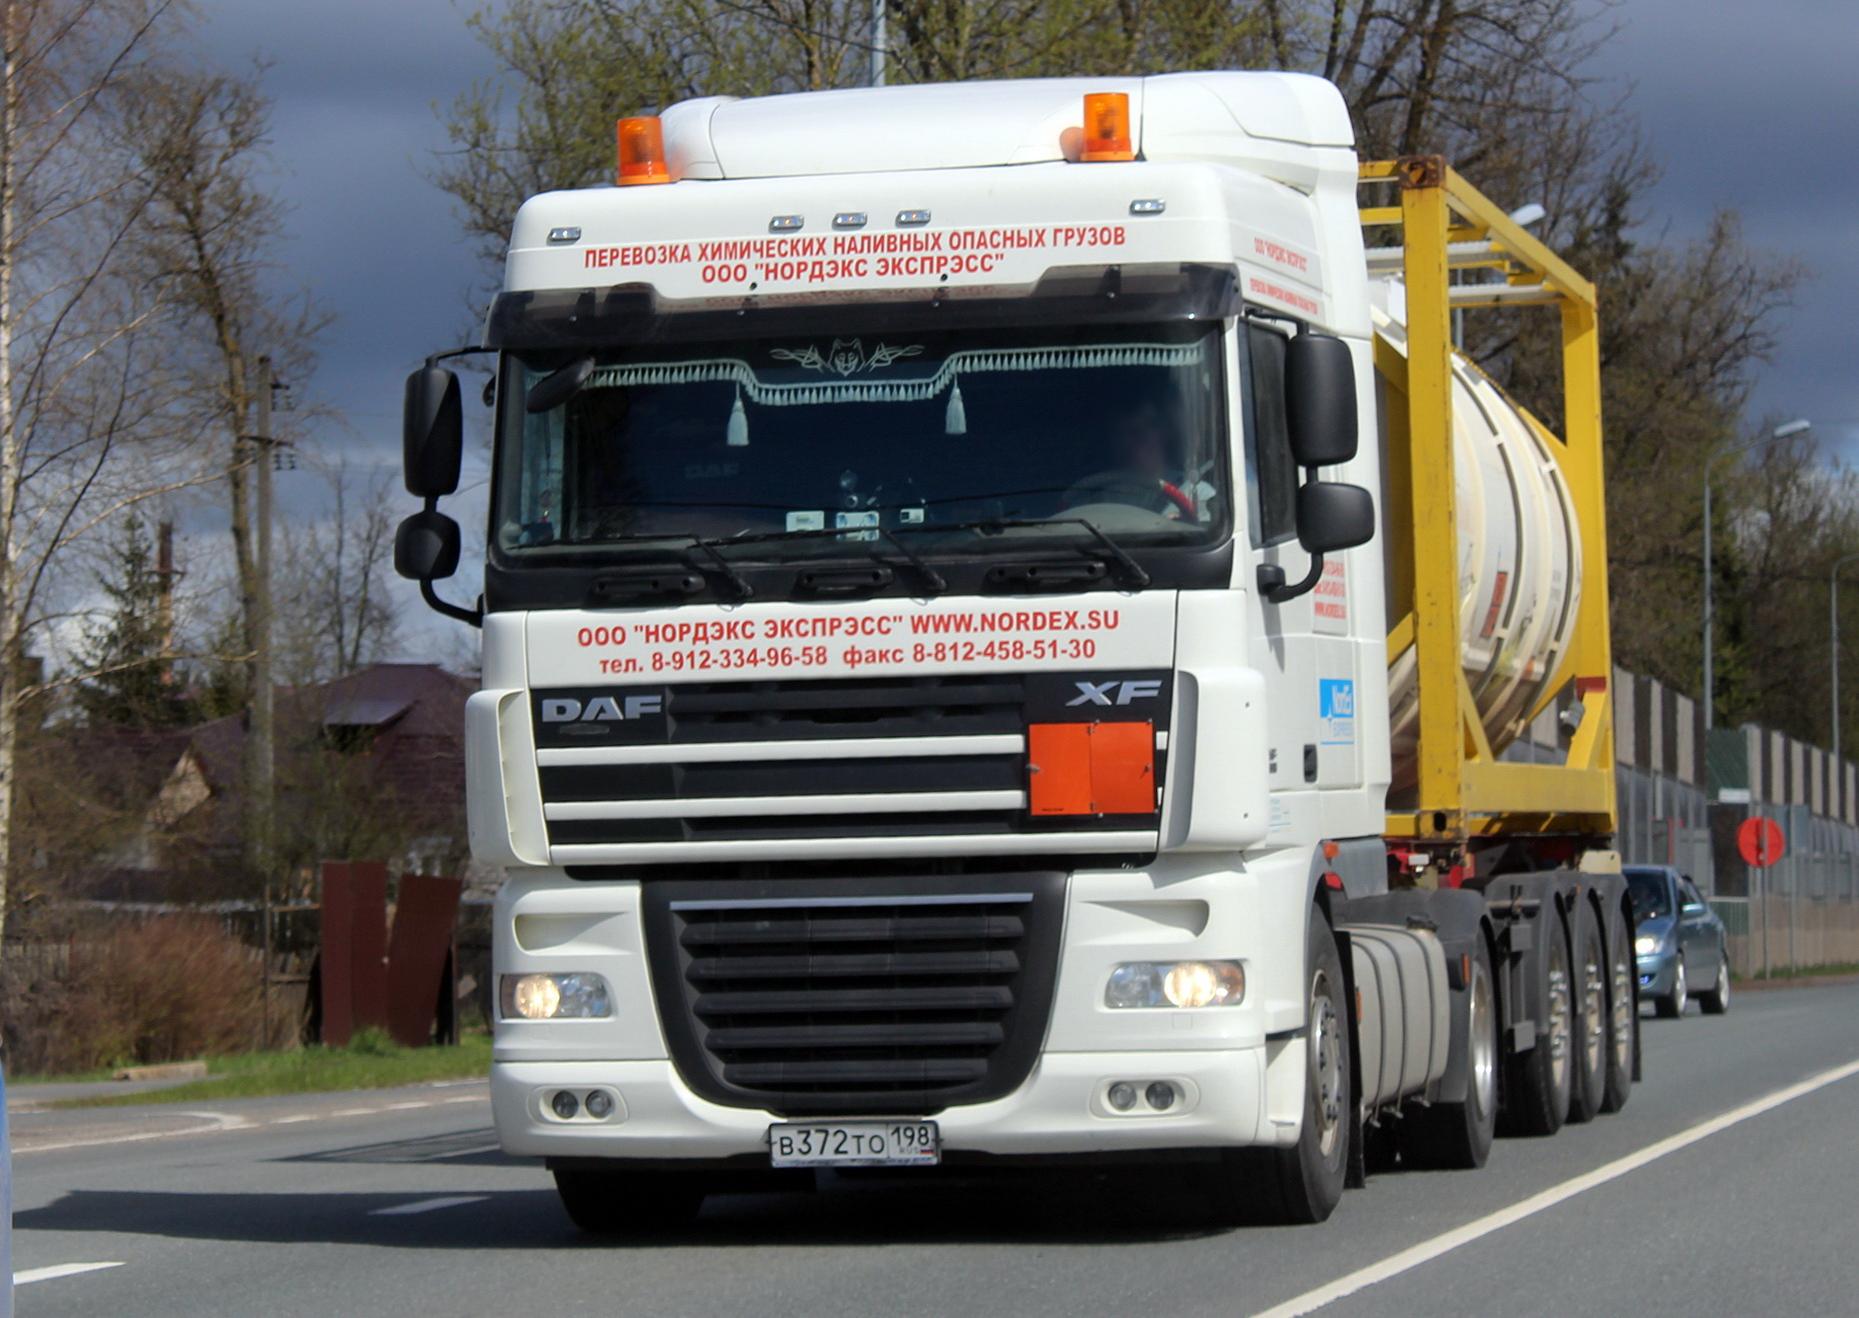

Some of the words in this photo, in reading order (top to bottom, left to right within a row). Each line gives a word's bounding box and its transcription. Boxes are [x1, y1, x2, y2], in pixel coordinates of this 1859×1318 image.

[585, 244, 692, 268] ПЕРЕВОЗКА
[698, 238, 827, 263] ХИМИЧЕСКИХ
[833, 232, 941, 255] НАЛИВНЫХ
[949, 229, 1046, 251] ОПАСНЫХ
[1052, 226, 1126, 248] ГРУЗОВ
[701, 262, 748, 283] ООО
[754, 258, 868, 282] "НОРДЭКС
[875, 252, 1004, 277] ЭКСПРЭСС"
[577, 626, 627, 647] ООО
[634, 619, 756, 645] "НОРДЭКС
[764, 615, 903, 640] ЭКСПРЭСС"
[911, 609, 1120, 635] WWW.NORDEX.SU
[599, 657, 645, 674] тел.
[652, 646, 828, 672] 8-912-334-96-58
[842, 646, 905, 668] факс
[912, 638, 1096, 662] 8-812-458-51-30
[1065, 679, 1162, 706] XF
[542, 695, 662, 722] DAF
[891, 1126, 929, 1147] 198
